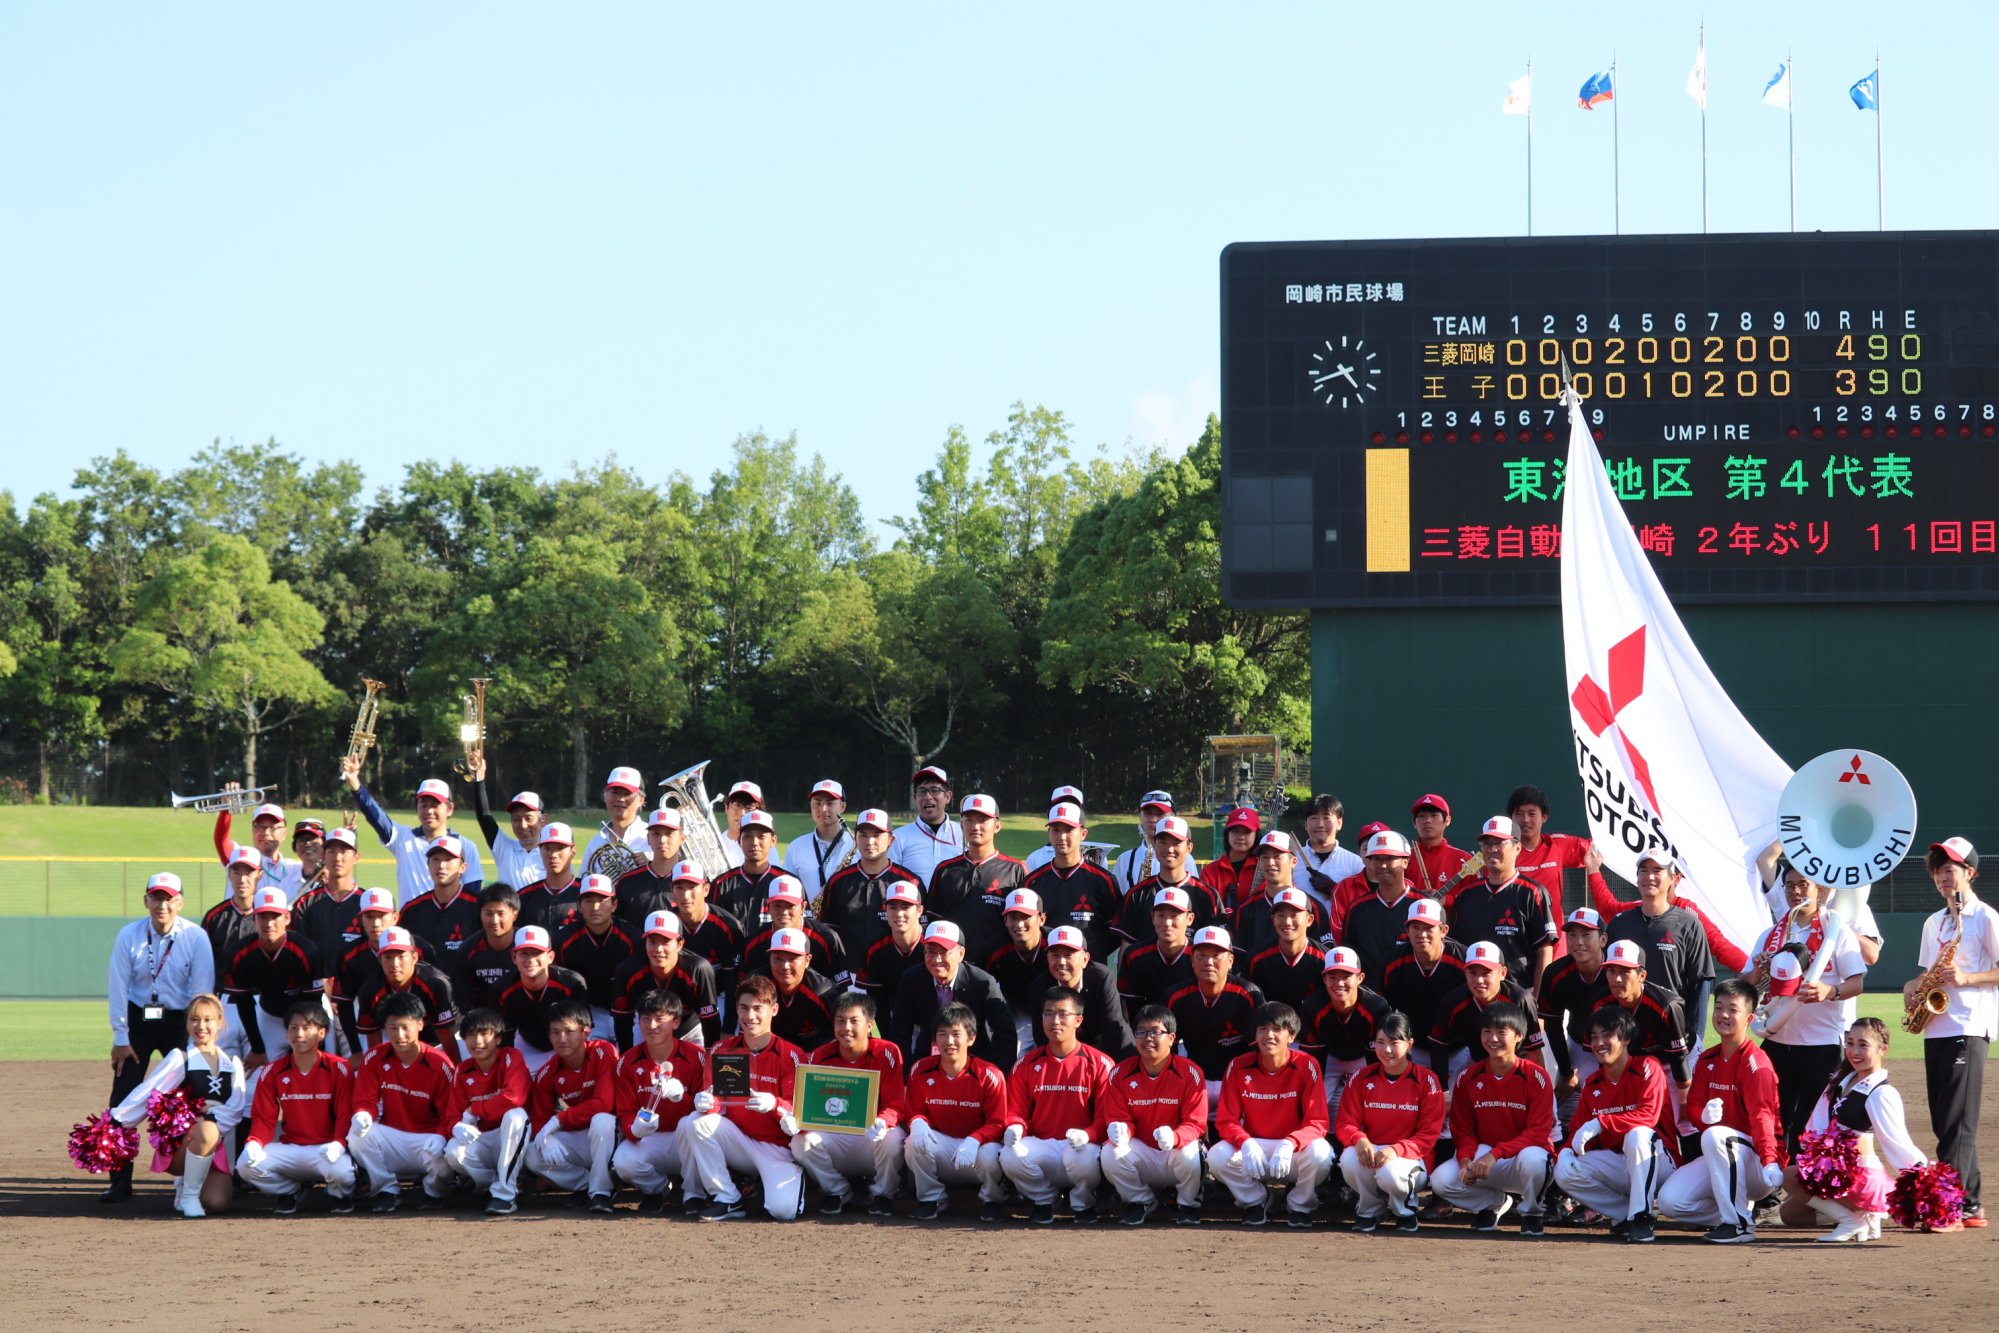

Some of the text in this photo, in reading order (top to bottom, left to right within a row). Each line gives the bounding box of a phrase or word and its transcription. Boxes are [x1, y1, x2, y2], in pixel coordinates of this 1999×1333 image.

[1285, 282, 1404, 304] 岡崎市民球場
[1432, 310, 1916, 336] TEAM 1 2 3 4 5 6 7 8 9 10 R H E
[1423, 335, 1920, 366] 三菱岡崎 0 0 0 2 0 0 2 0 0 4 9 0
[1507, 374, 1526, 399] 0
[1540, 374, 1559, 399] 0
[1573, 373, 1592, 398] 0
[1606, 373, 1625, 398] 0
[1643, 372, 1651, 397] 1
[1672, 372, 1691, 397] 0
[1705, 371, 1724, 397] 2
[1738, 371, 1757, 396] 0
[1771, 370, 1790, 396] 0
[1836, 370, 1855, 395] 3
[1869, 370, 1888, 395] 9
[1902, 370, 1921, 395] 0
[1398, 412, 1405, 428] 1
[1422, 412, 1432, 427] 2
[1446, 412, 1457, 427] 3
[1470, 411, 1481, 427] 4
[1495, 411, 1505, 426] 5
[1519, 410, 1530, 426] 6
[1544, 410, 1554, 425] 7
[1592, 409, 1603, 424] 9
[1813, 405, 1994, 421] 1 2 3 4 5 6 7 8
[1664, 424, 1750, 441] UMPIRE
[1780, 815, 1911, 886] MITSUBISHI
